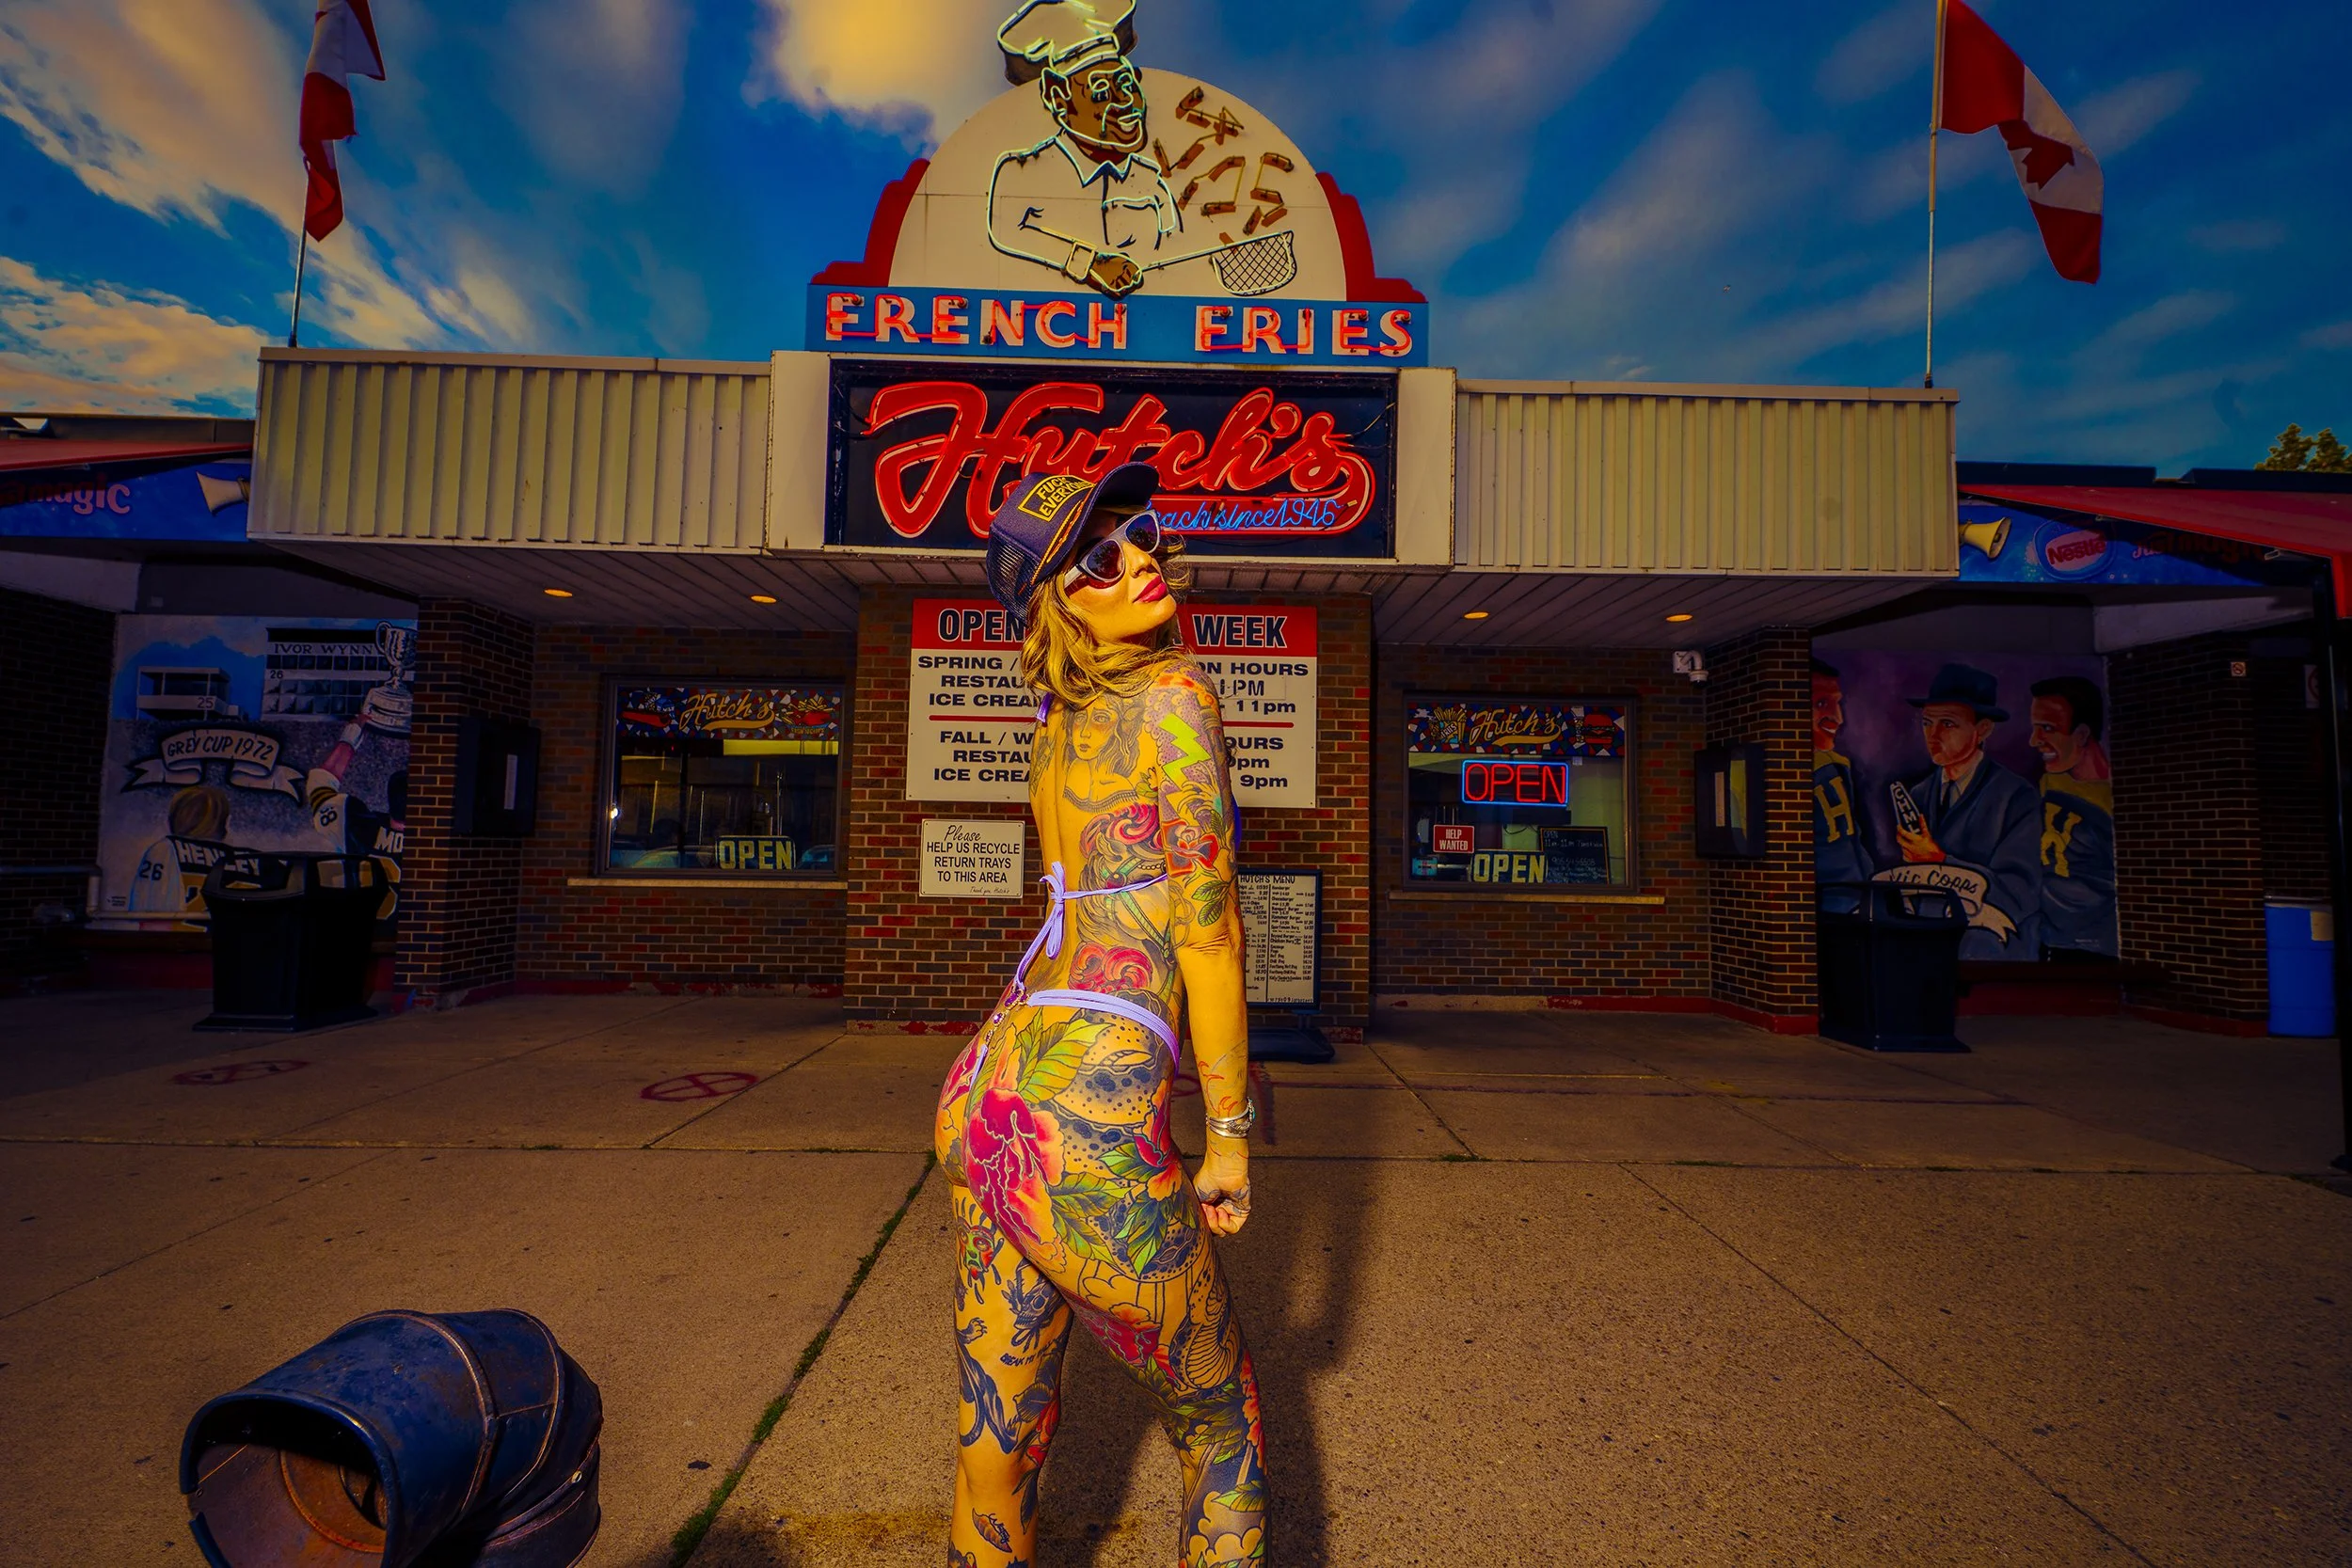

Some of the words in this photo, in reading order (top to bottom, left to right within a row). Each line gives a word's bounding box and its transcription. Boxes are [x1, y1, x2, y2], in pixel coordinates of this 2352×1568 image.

[825, 293, 1128, 351] FRENCH
[1195, 305, 1413, 357] FRIES
[862, 382, 1375, 539] Hutch's
[1037, 477, 1069, 500] FUCK
[1039, 481, 1090, 516] EVERYO
[1216, 502, 1277, 530] since
[1279, 498, 1342, 528] 1946
[938, 608, 1026, 643] OPEN
[1192, 613, 1288, 649] WEEK
[274, 643, 312, 655] IVOR
[917, 656, 1003, 670] SPRING
[1231, 662, 1309, 676] HOURS
[270, 670, 284, 679] 26
[941, 674, 1024, 689] RESTAU
[197, 697, 215, 709] 25
[929, 692, 966, 706] ICE
[678, 689, 775, 731] Hutch's
[1236, 700, 1296, 716] 11pm
[1470, 707, 1563, 747] Hutch's
[940, 731, 992, 744] FALL
[1013, 733, 1035, 745] W
[1224, 736, 1284, 751] OURS
[167, 736, 200, 757] GREY
[202, 736, 233, 753] CUP
[234, 736, 274, 760] 1972
[953, 750, 1032, 764] RESTAU
[1227, 755, 1270, 771] 0pm
[933, 768, 971, 782] ICE
[1240, 774, 1288, 790] 9pm
[1465, 763, 1566, 804] OPEN
[373, 825, 405, 853] MO
[944, 824, 981, 842] Please
[1445, 829, 1463, 840] HELP
[927, 841, 953, 853] HELP
[956, 842, 970, 853] US
[972, 843, 1020, 854] RECYCLE
[1438, 839, 1469, 851] WANTED
[718, 840, 793, 870] OPEN
[934, 856, 976, 868] RETURN
[978, 857, 1011, 868] TRAYS
[138, 860, 164, 881] 26
[1472, 853, 1546, 883] OPEN
[937, 870, 951, 881] TO
[954, 871, 977, 882] THIS
[978, 872, 1008, 883] AREA
[1273, 875, 1295, 884] MENU
[1928, 869, 1978, 895] Copps
